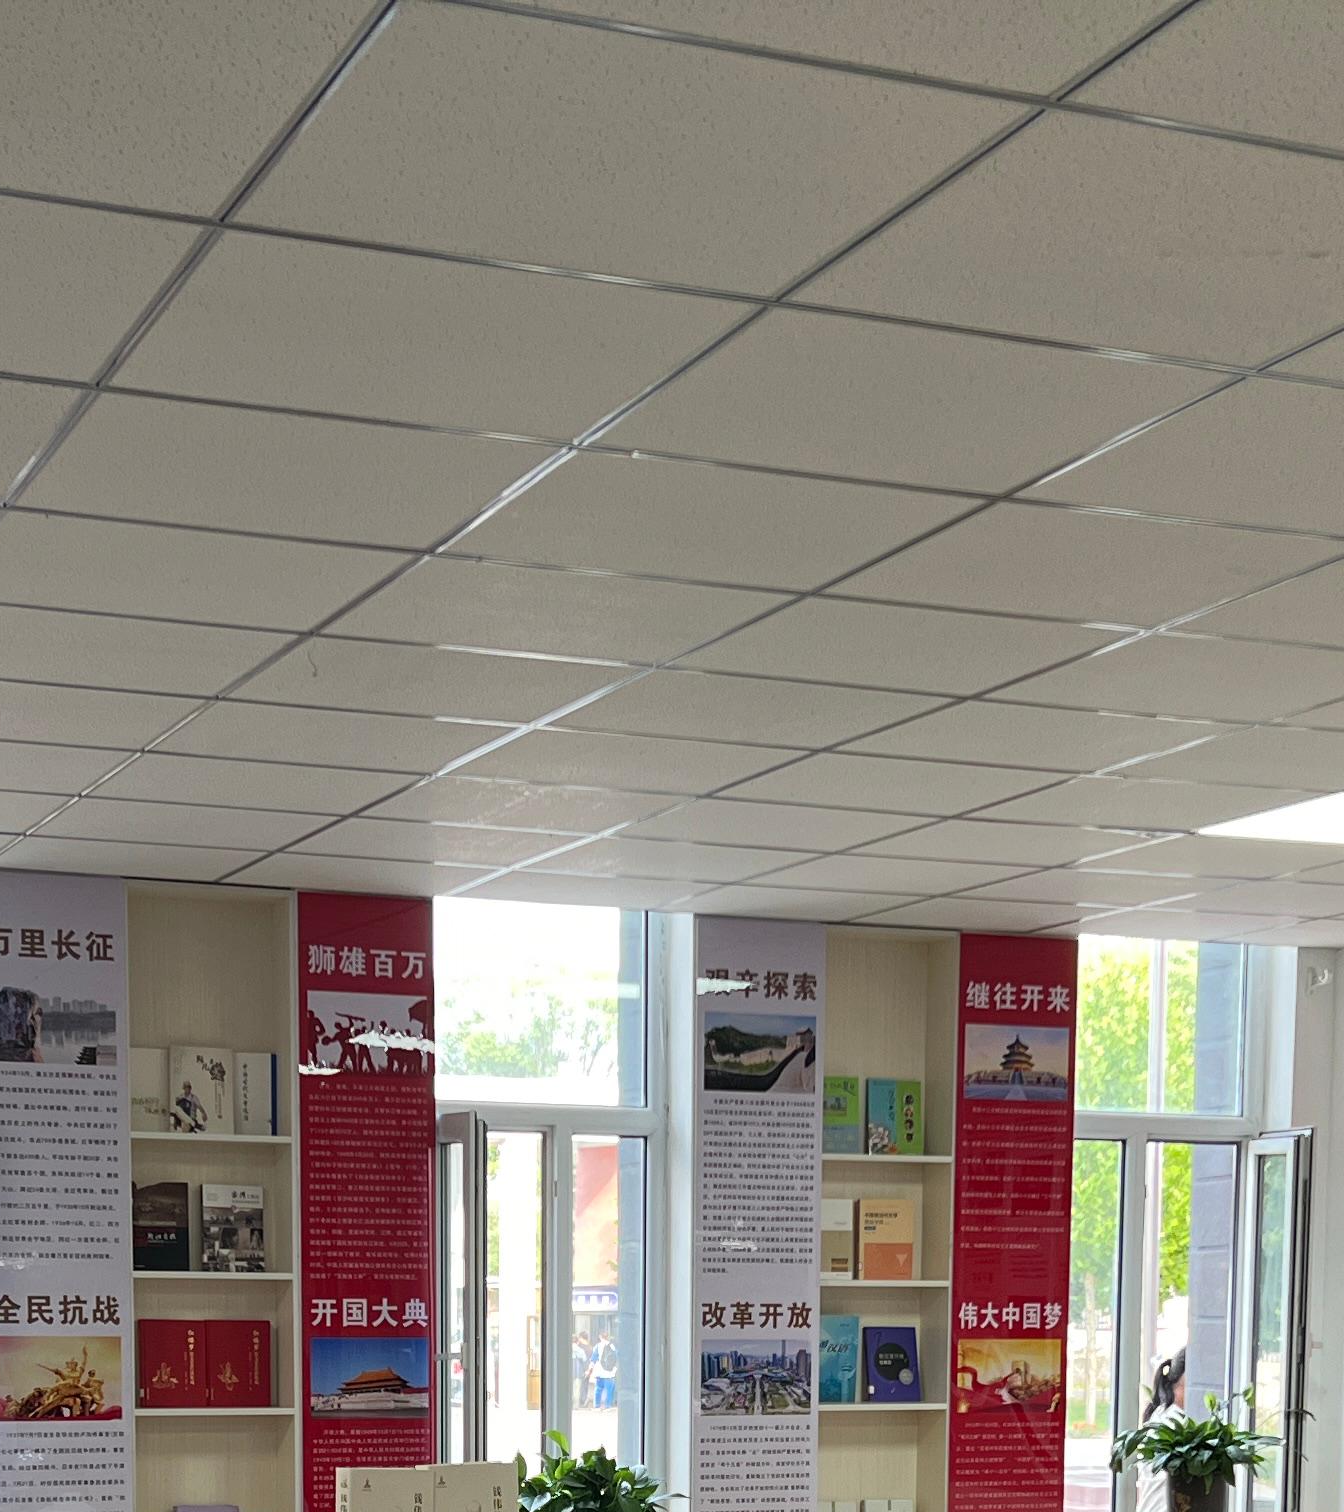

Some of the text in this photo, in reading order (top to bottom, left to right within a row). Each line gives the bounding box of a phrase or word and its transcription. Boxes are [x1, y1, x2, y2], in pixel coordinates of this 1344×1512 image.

[308, 944, 427, 979] 狮雄百万
[965, 981, 1070, 1013] 继往开来
[311, 1298, 429, 1328] 开国大典
[701, 1301, 812, 1329] 改革开放
[958, 1301, 1063, 1331] 伟大中国梦
